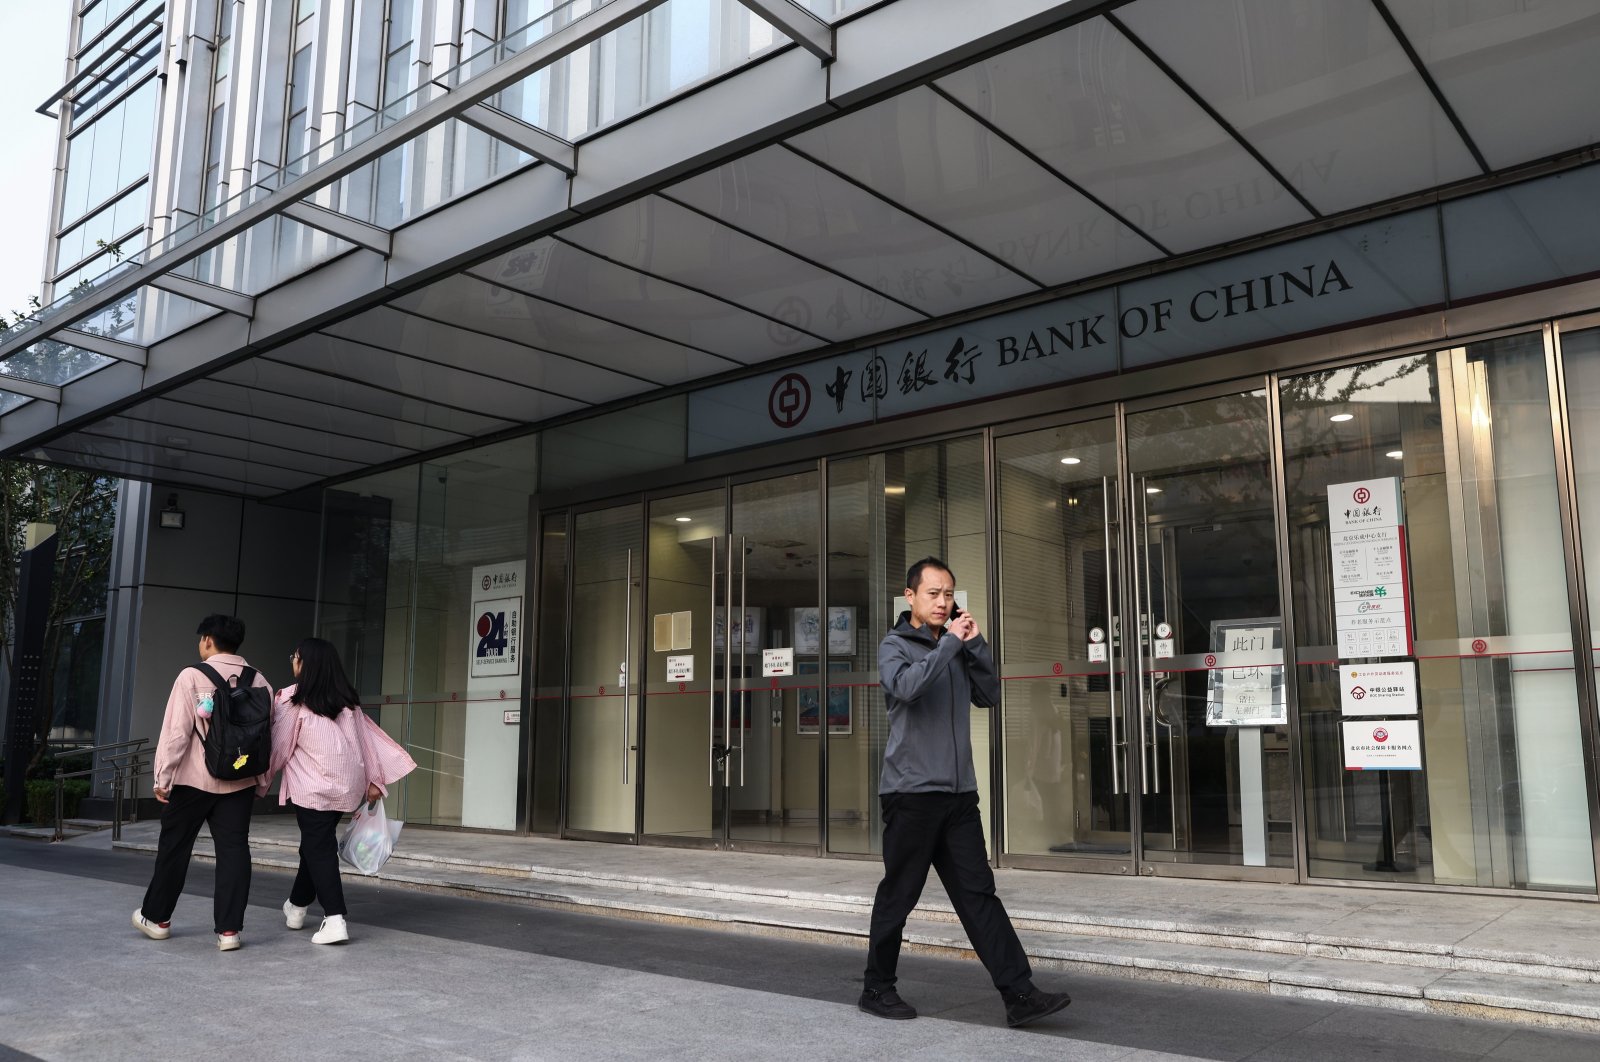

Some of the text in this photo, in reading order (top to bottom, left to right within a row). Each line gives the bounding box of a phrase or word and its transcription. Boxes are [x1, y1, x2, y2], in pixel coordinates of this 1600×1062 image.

[995, 259, 1354, 367] BANK OF CHINA
[485, 647, 498, 657] HOUR
[1232, 636, 1265, 652] 此门
